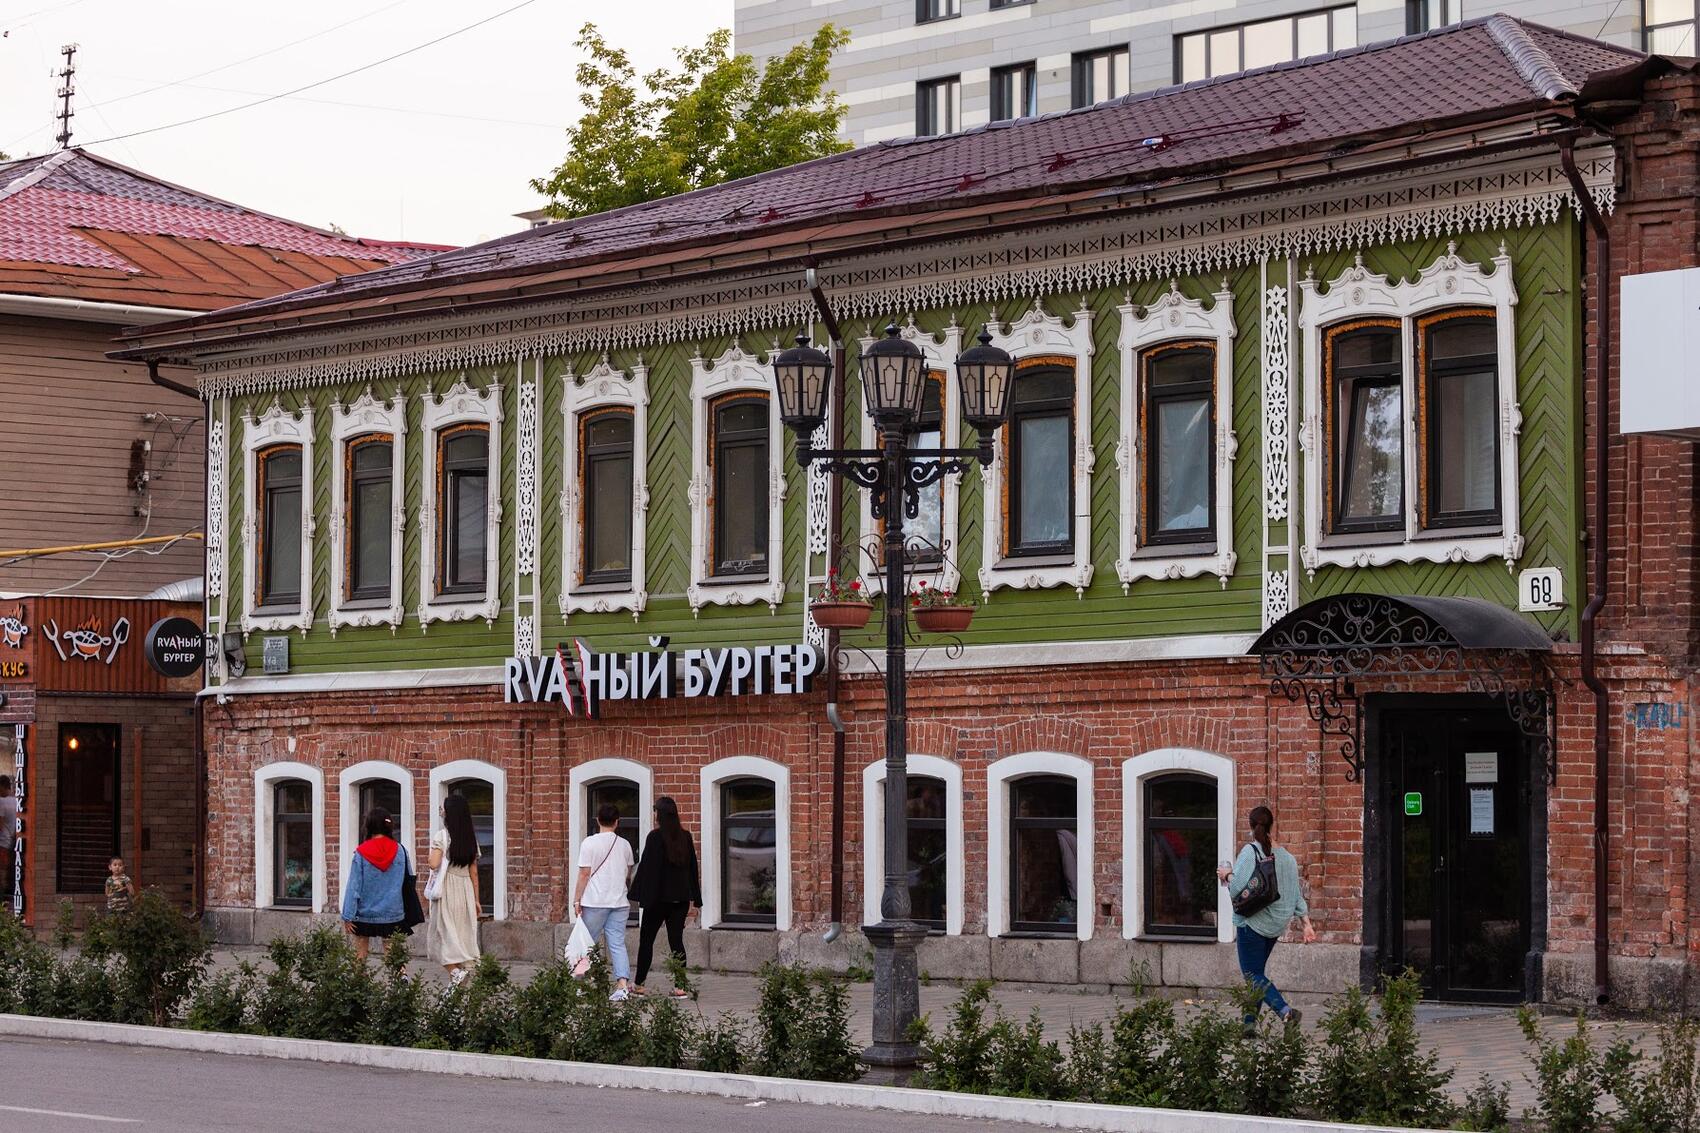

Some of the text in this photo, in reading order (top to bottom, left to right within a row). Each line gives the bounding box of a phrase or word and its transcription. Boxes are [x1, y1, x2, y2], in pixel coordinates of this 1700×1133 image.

[1531, 576, 1551, 604] 68
[164, 653, 195, 662] БУРГЕР
[0, 662, 25, 677] КУС
[684, 644, 820, 698] БУРГЕР
[15, 724, 24, 813] ШАШЛЫК
[16, 818, 22, 833] В
